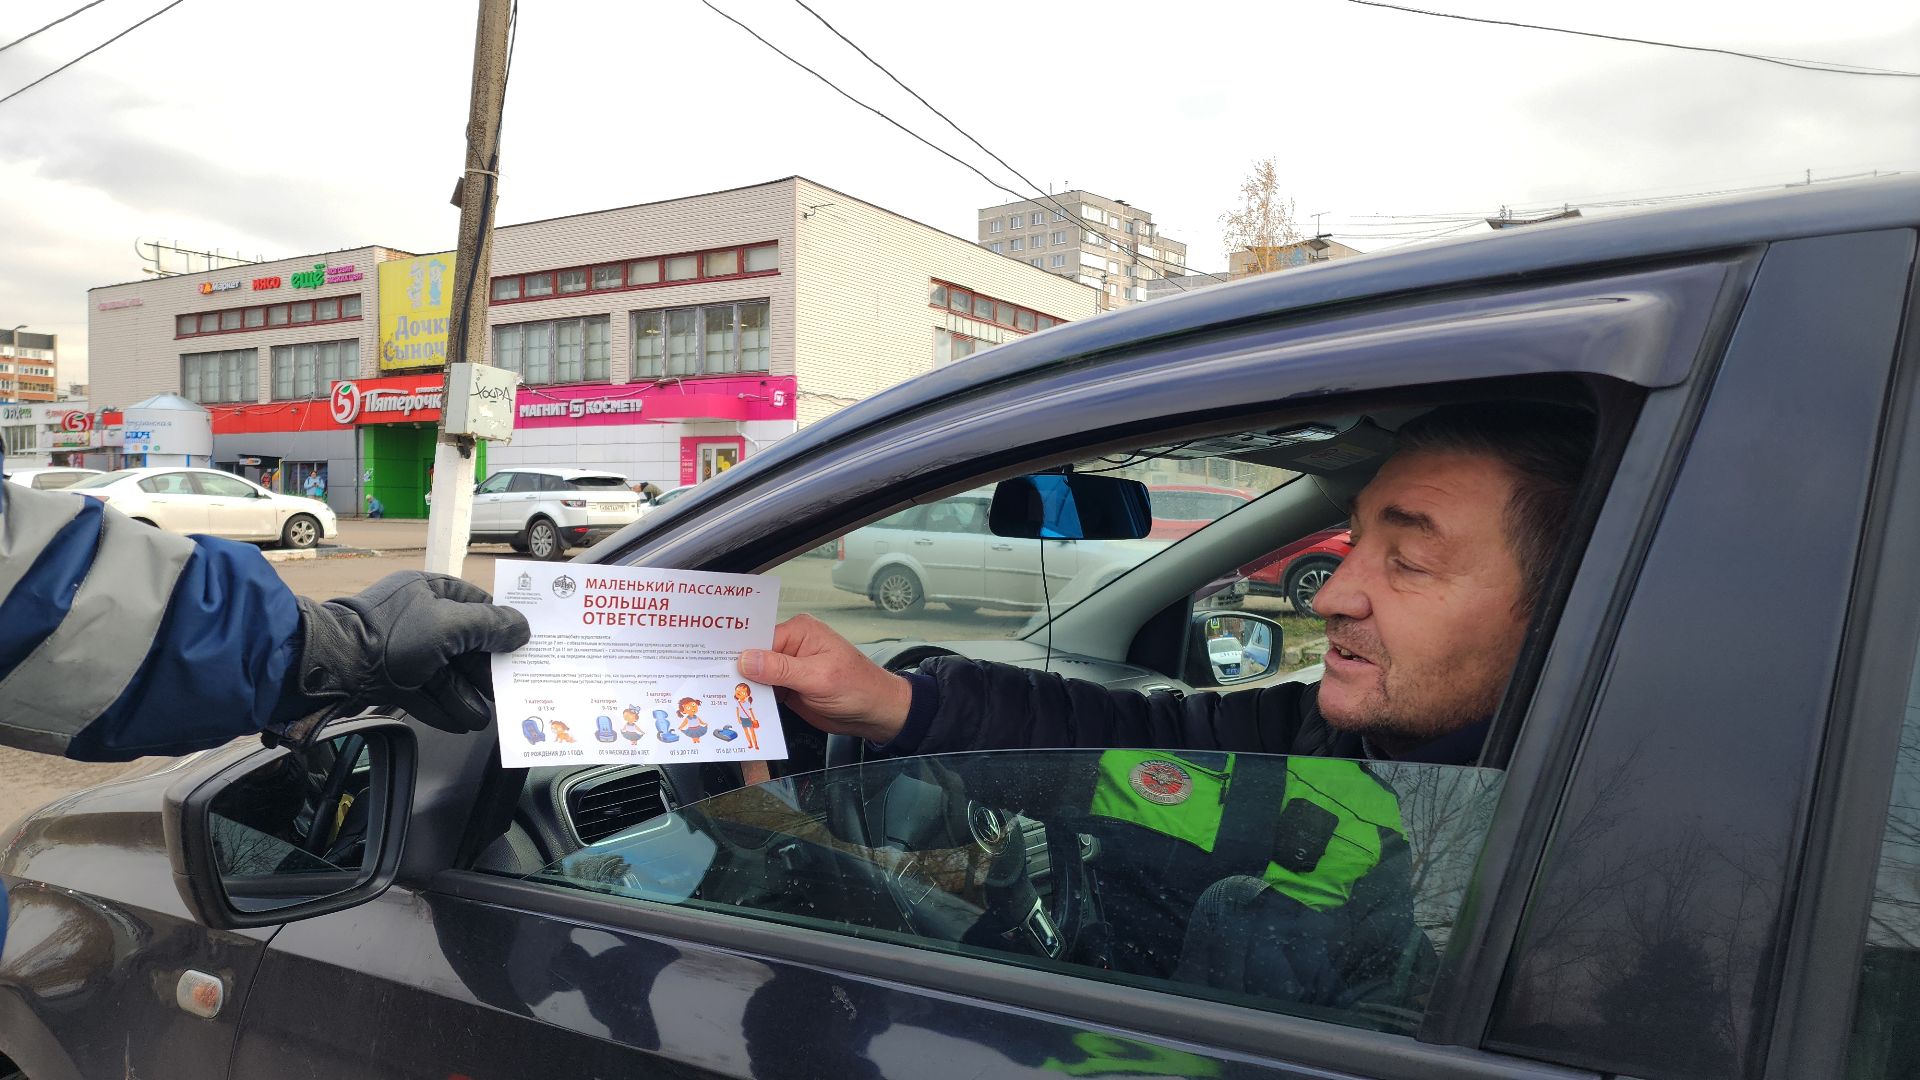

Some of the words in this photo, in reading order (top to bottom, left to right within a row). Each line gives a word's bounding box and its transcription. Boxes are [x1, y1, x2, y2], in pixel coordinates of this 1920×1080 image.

[291, 264, 325, 289] ещё
[384, 341, 445, 361] Сыноч
[519, 402, 568, 417] МАГНИТ
[585, 578, 674, 593] МАЛЕНЬКИЙ
[678, 583, 753, 597] ПАССАЖИР
[584, 595, 669, 611] БОЛЬШАЯ
[582, 611, 749, 630] ОТВЕТСТВЕННОСТЬ!
